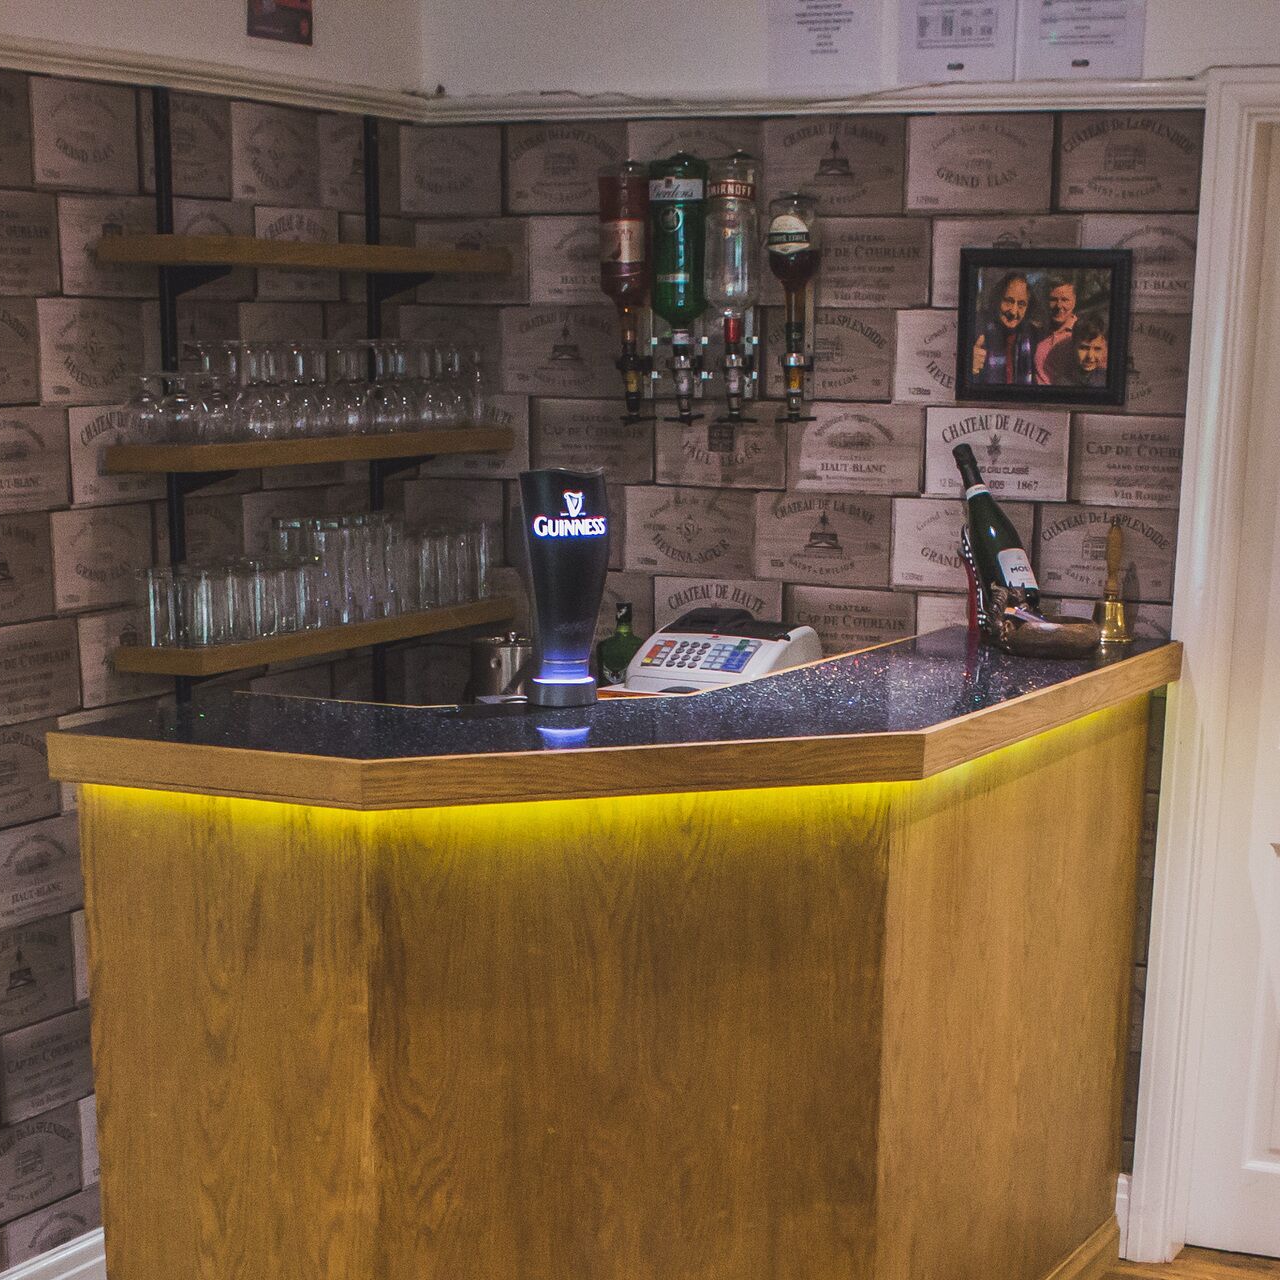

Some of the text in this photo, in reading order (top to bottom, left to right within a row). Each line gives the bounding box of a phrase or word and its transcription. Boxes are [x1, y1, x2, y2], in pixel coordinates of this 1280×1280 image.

[936, 166, 979, 189] GRAND
[995, 413, 1011, 431] DE
[1014, 417, 1052, 447] HAUTE
[1086, 441, 1112, 455] CAP
[820, 462, 886, 474] HAUT-BLANC
[1017, 480, 1039, 491] 1867
[1113, 489, 1132, 500] Vin
[532, 514, 608, 538] GUINNESS
[921, 547, 962, 569] GRAND
[714, 583, 729, 597] DE
[733, 586, 766, 614] HAUTE
